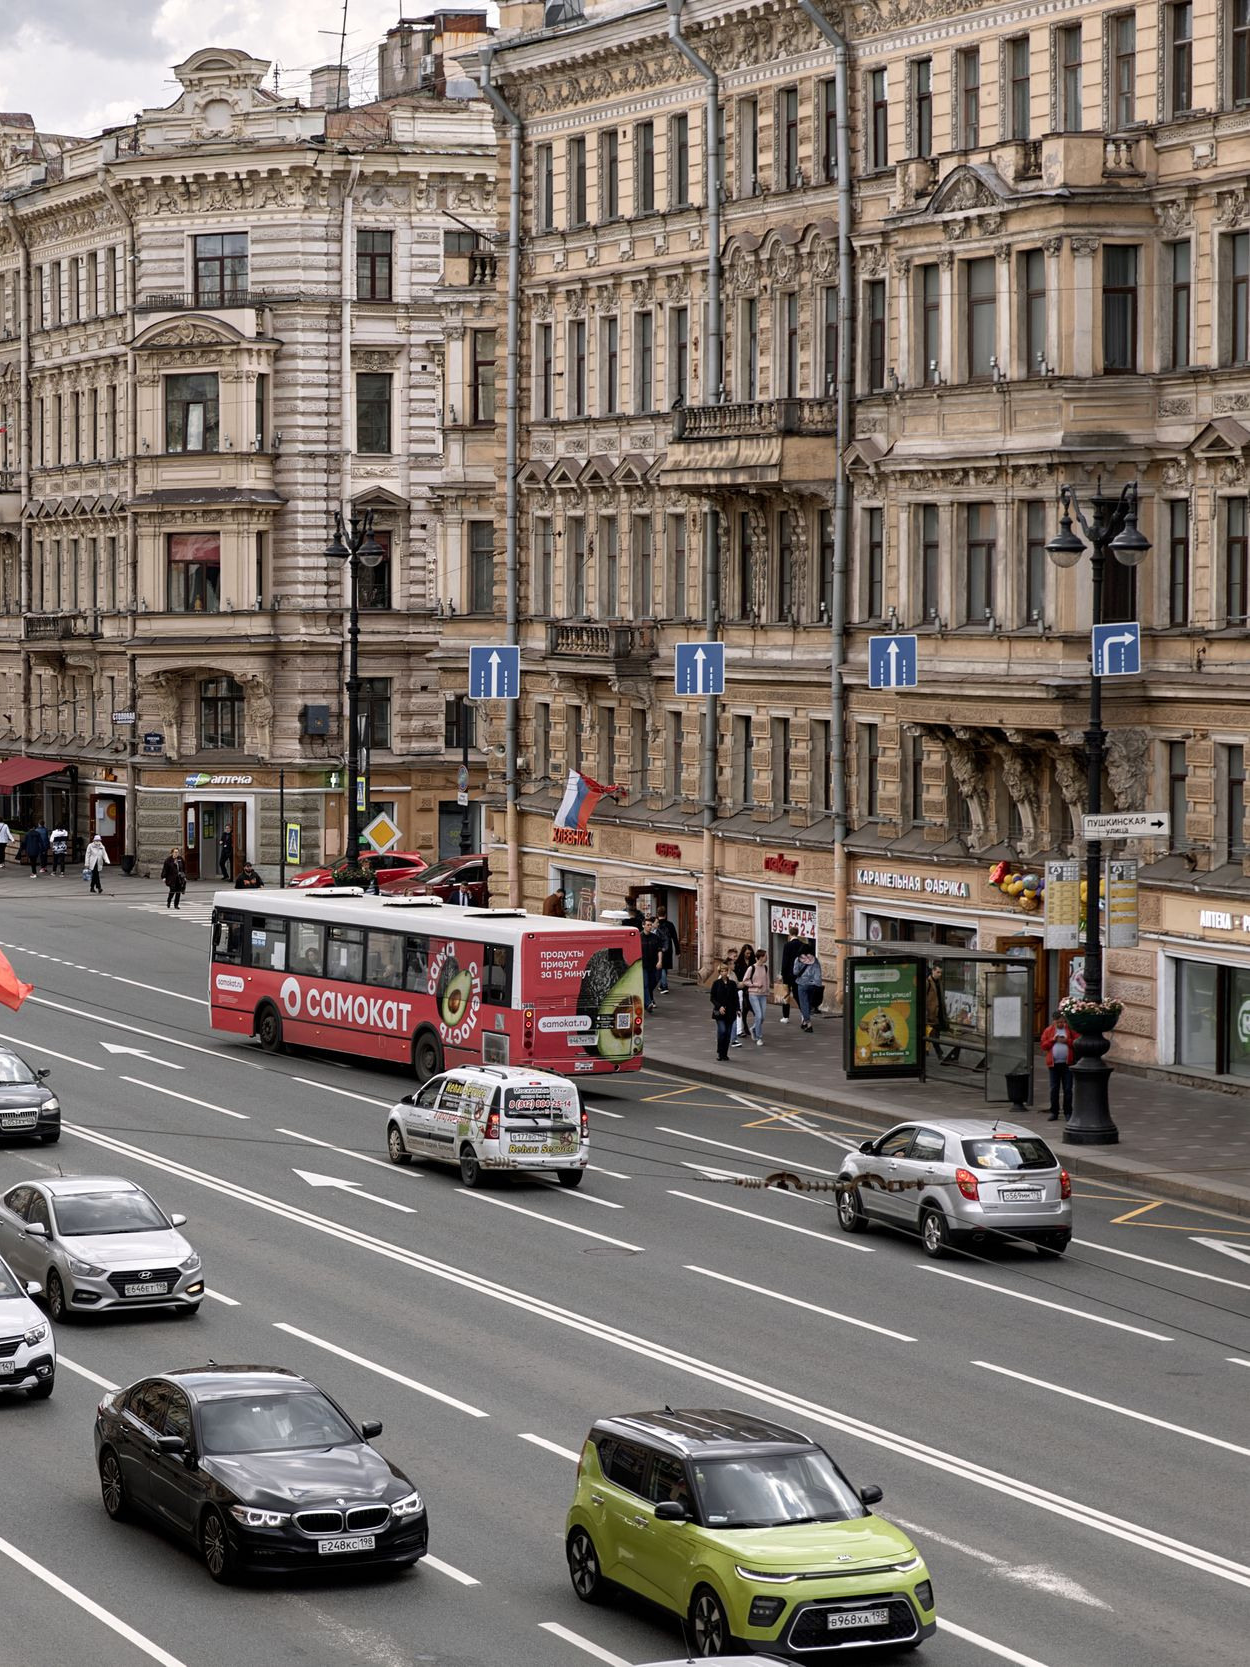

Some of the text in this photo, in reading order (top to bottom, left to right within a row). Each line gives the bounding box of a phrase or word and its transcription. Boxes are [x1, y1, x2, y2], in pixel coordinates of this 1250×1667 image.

[211, 775, 252, 784] аптека
[1087, 817, 1147, 828] ПУШКИНСКАЯ
[553, 828, 592, 846] ХЛЕБНИК
[856, 869, 968, 897] КАРАМЕЛЬНАЯ ФАБРИКА
[781, 908, 813, 922] АРЕНДА
[1200, 910, 1232, 929] АПТЕКА
[540, 950, 584, 960] продукты
[540, 960, 579, 970] приедут
[541, 970, 592, 980] за 15 минут
[542, 1018, 588, 1028] samokat.ru
[509, 1144, 575, 1154] Rehau Service
[321, 1537, 373, 1552] Е248КС 198
[831, 1610, 886, 1627] В968ХА 198
